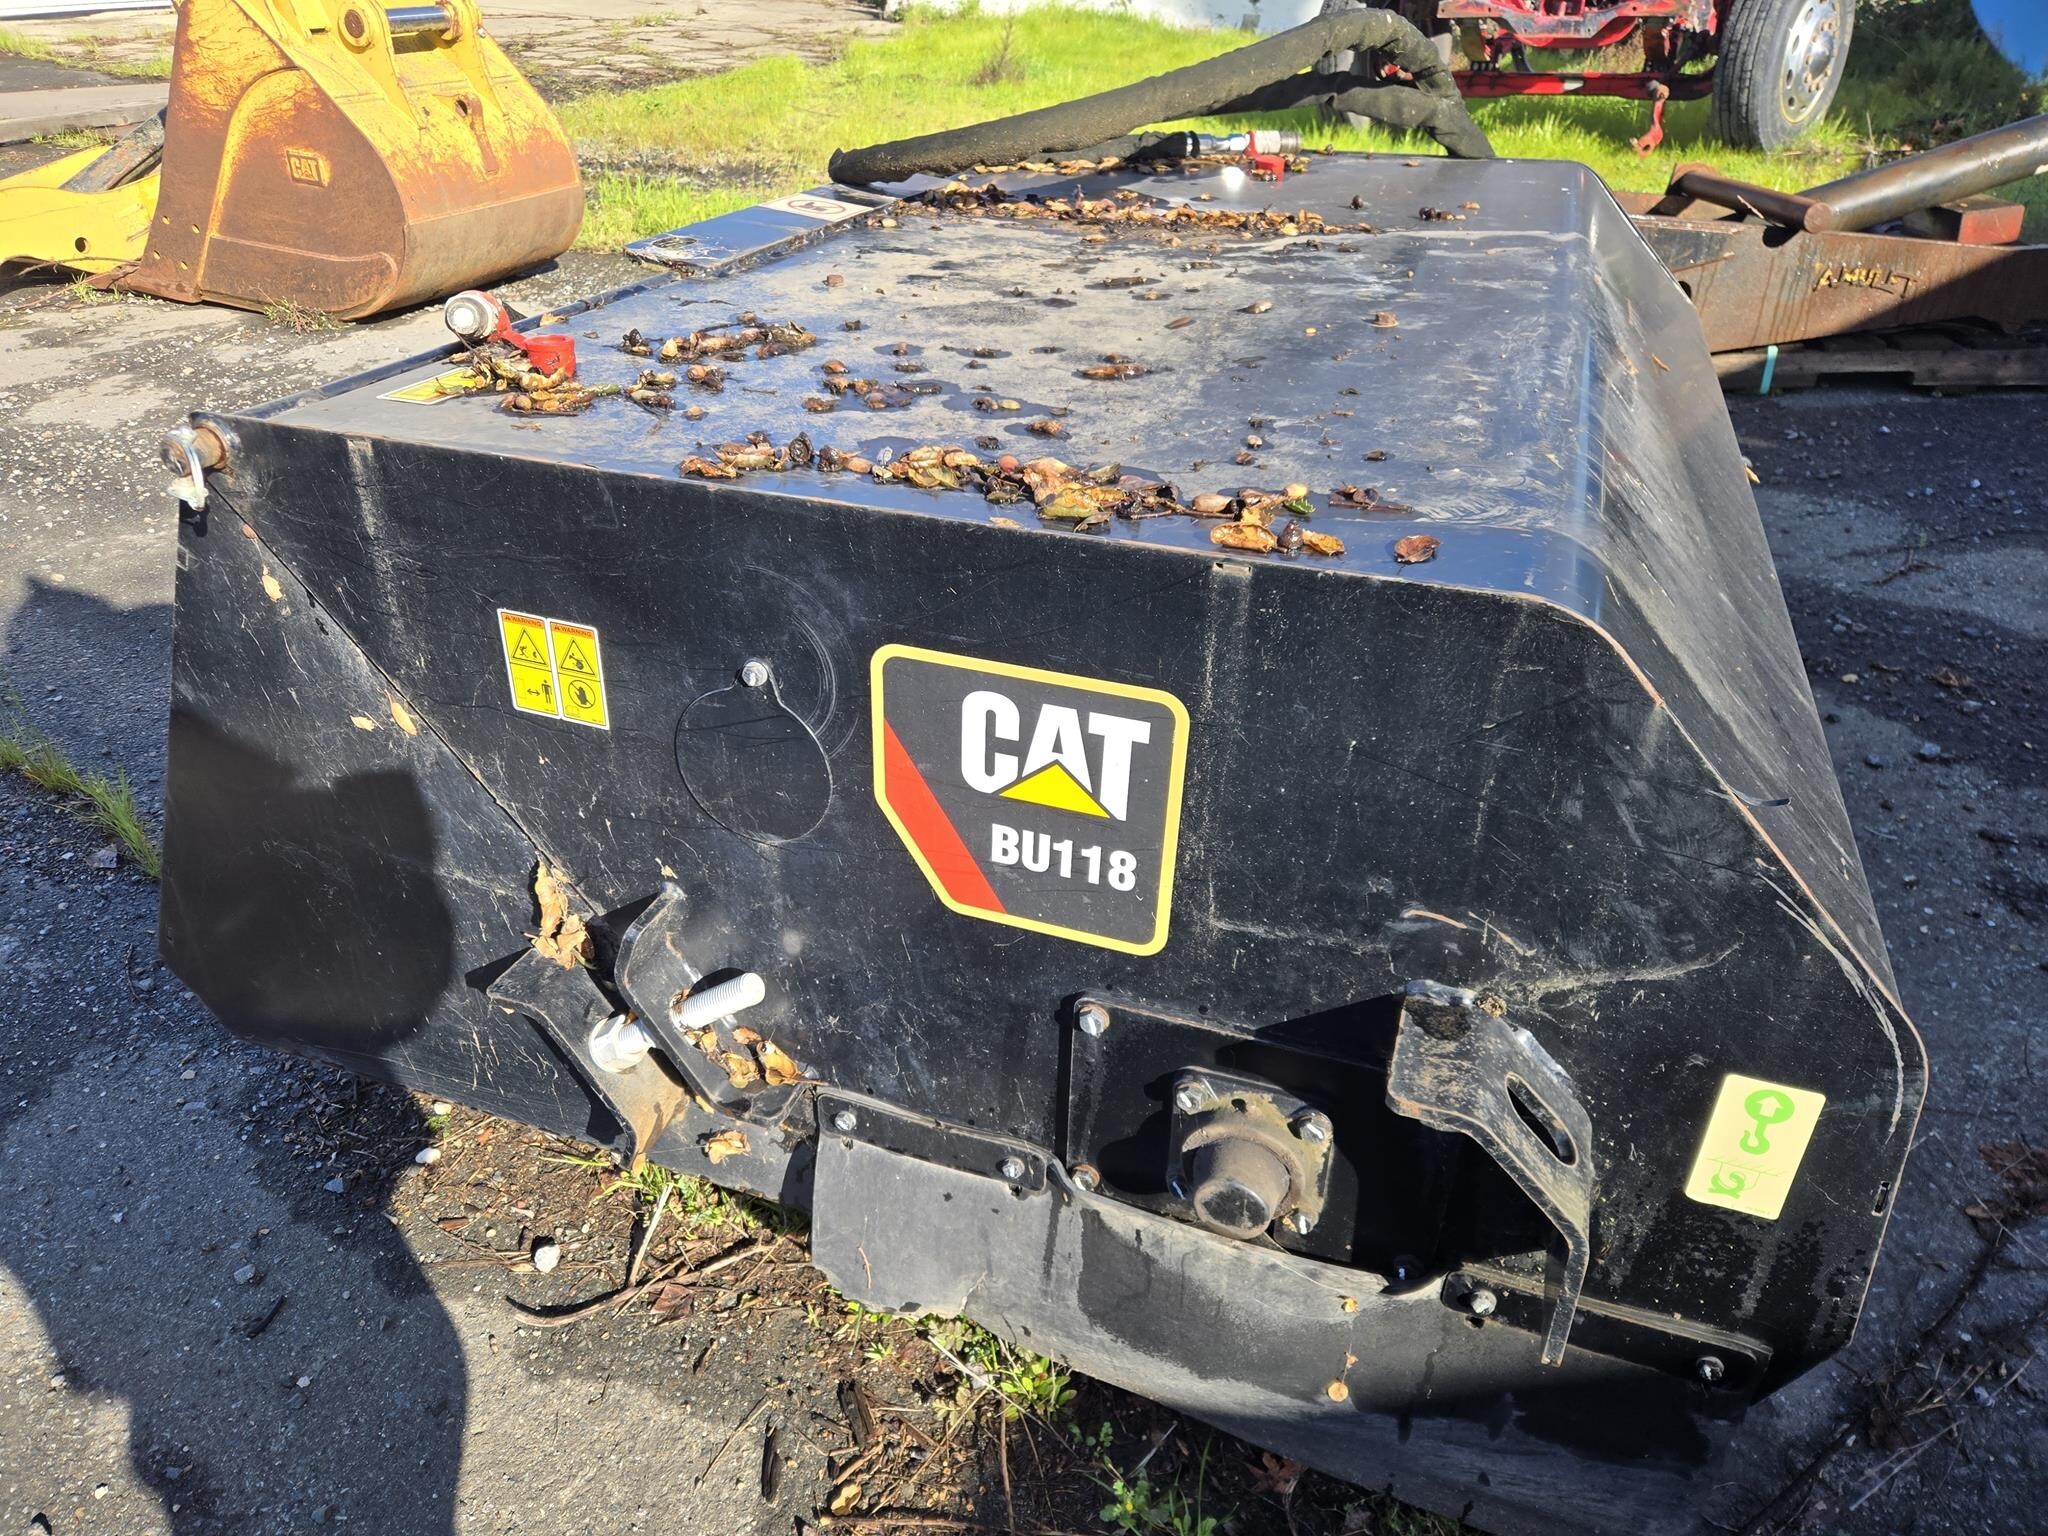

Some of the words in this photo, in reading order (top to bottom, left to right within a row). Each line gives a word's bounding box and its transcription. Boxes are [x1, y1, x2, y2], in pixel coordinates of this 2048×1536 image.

[290, 156, 319, 182] CAT
[512, 616, 542, 628] WARNING
[562, 626, 592, 638] WARNING
[961, 690, 1151, 821] CAT
[991, 823, 1137, 892] BU118
